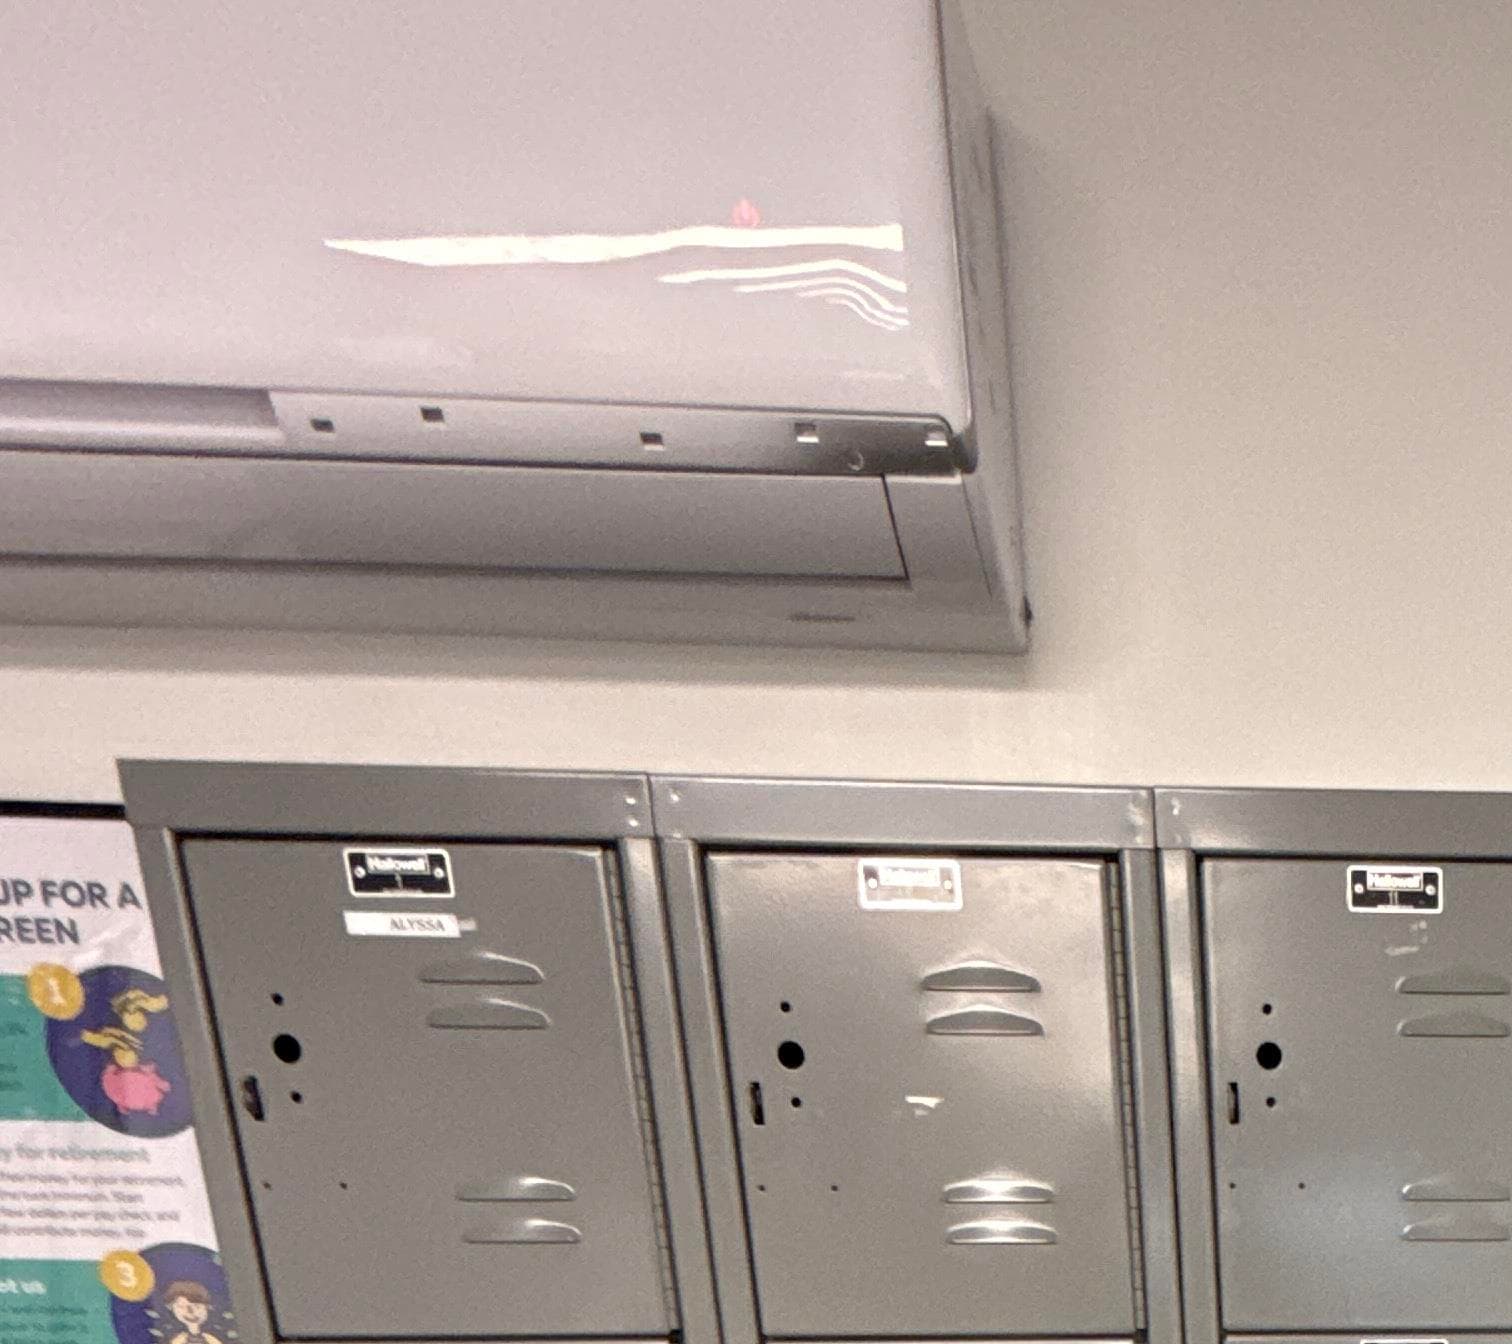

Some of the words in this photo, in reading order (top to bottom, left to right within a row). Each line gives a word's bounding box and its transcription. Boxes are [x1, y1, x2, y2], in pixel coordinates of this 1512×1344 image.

[41, 880, 111, 909] FOR
[117, 881, 143, 909] A
[390, 917, 447, 932] ALYSSA
[48, 978, 67, 1004] 1
[114, 1260, 138, 1289] 3
